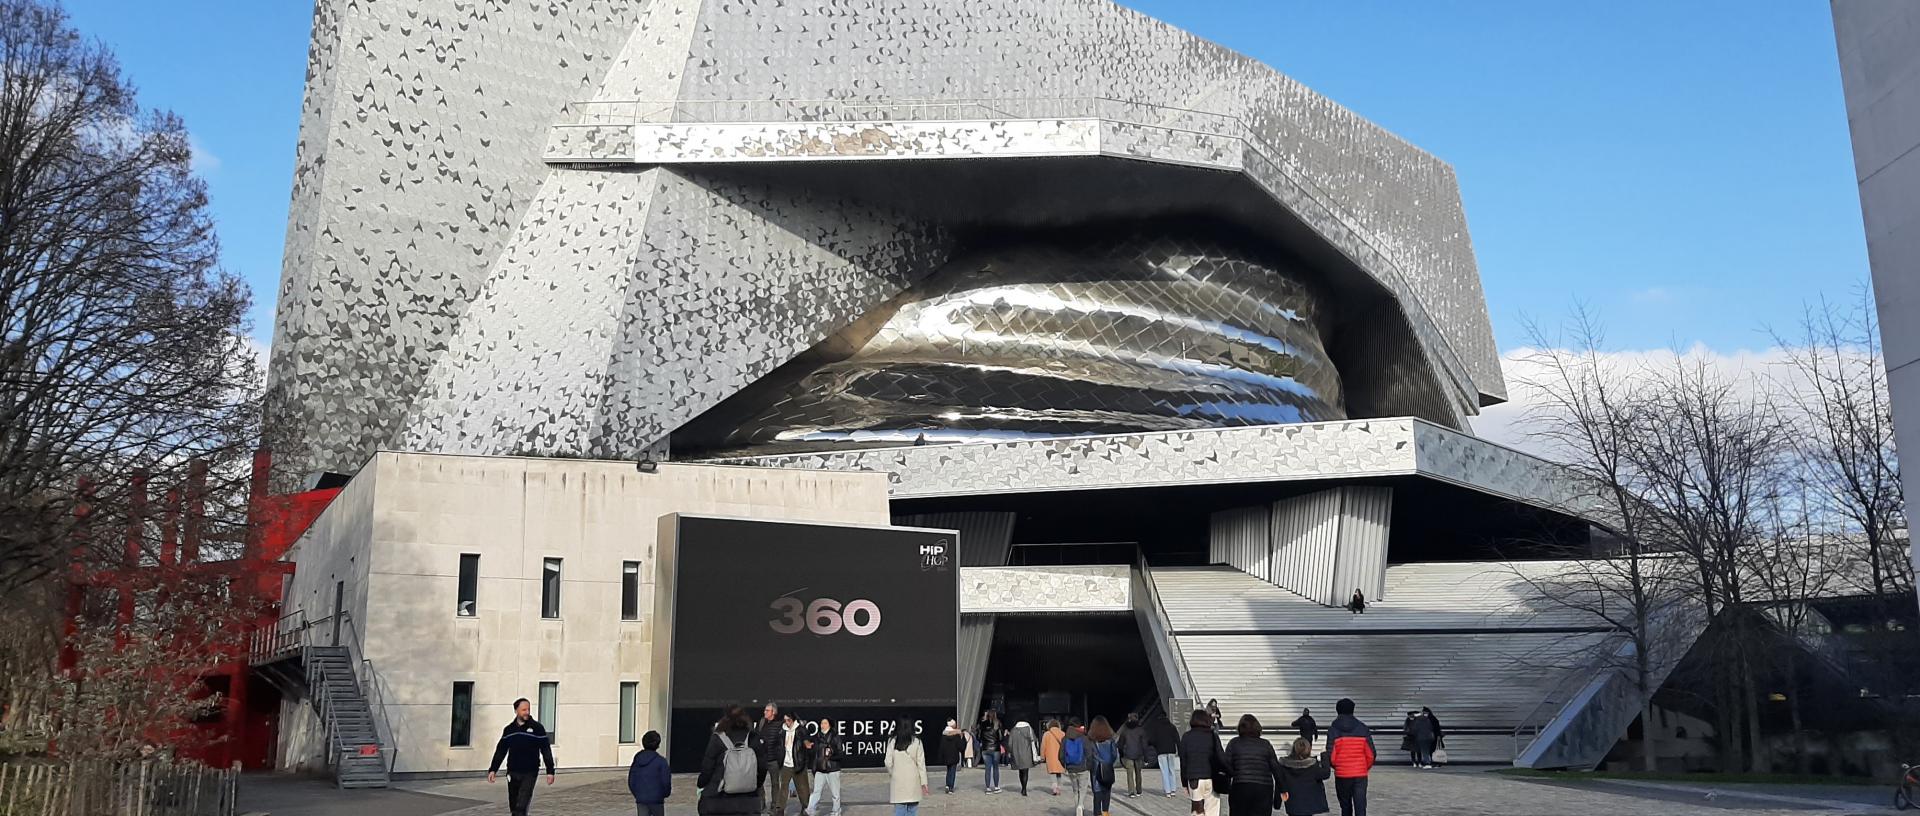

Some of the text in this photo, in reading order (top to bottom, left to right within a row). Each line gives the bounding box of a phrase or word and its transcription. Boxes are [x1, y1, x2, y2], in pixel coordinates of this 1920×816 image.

[769, 597, 881, 636] 360
[853, 720, 874, 735] DE
[880, 720, 923, 735] PAS
[842, 741, 886, 755] E PARI
